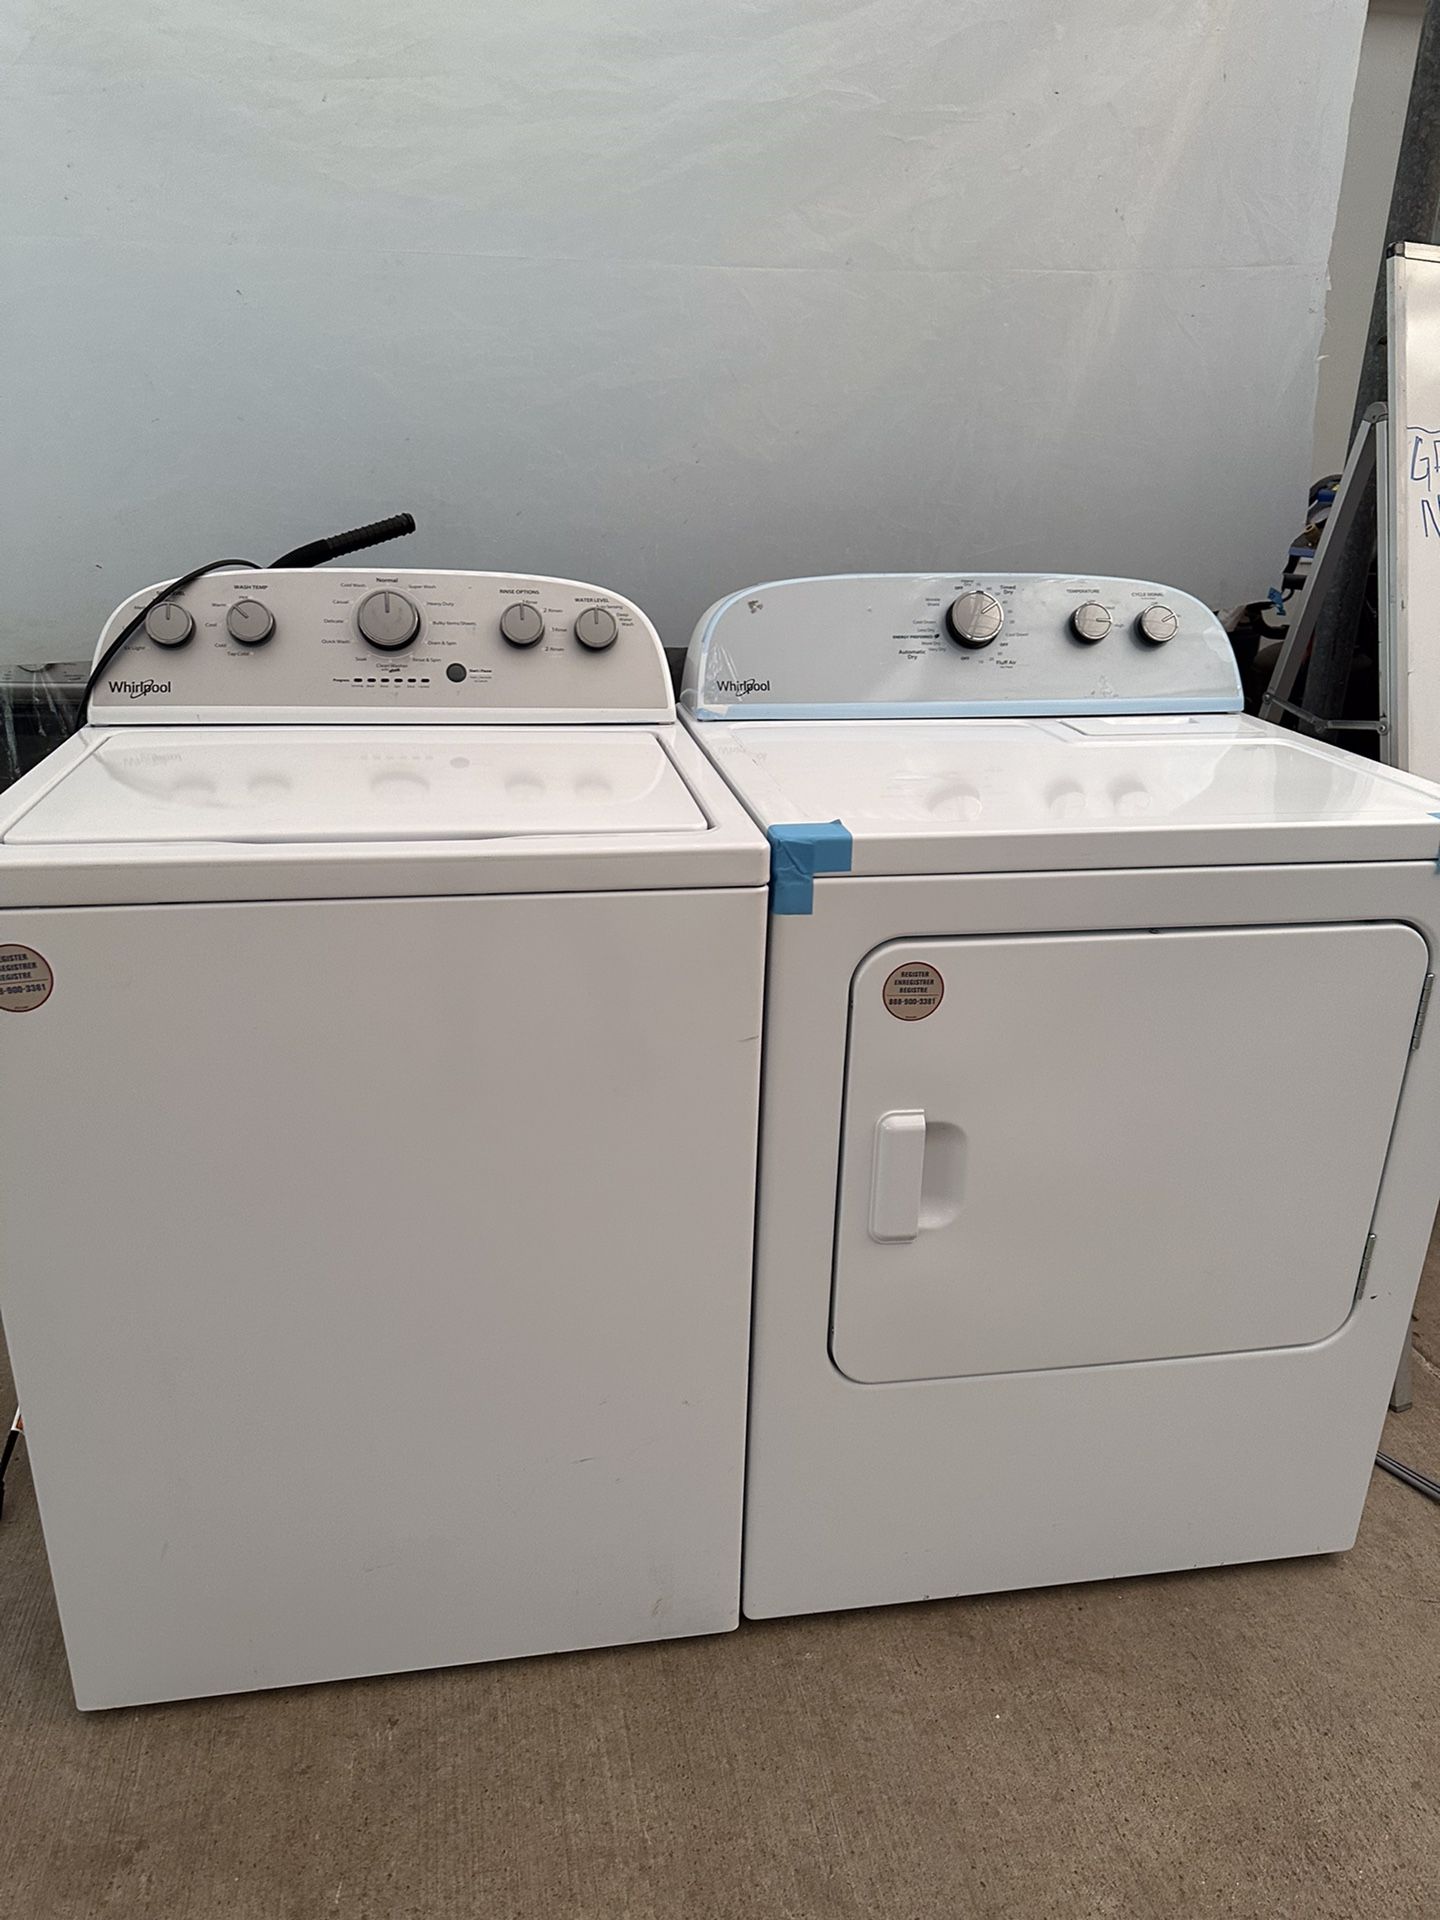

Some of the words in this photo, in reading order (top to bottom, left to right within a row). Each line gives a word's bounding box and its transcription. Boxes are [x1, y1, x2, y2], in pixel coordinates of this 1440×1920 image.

[1410, 435, 1440, 492] G
[907, 654, 918, 662] Dry
[108, 680, 172, 699] Whirlpool
[716, 678, 771, 697] Whirlpool
